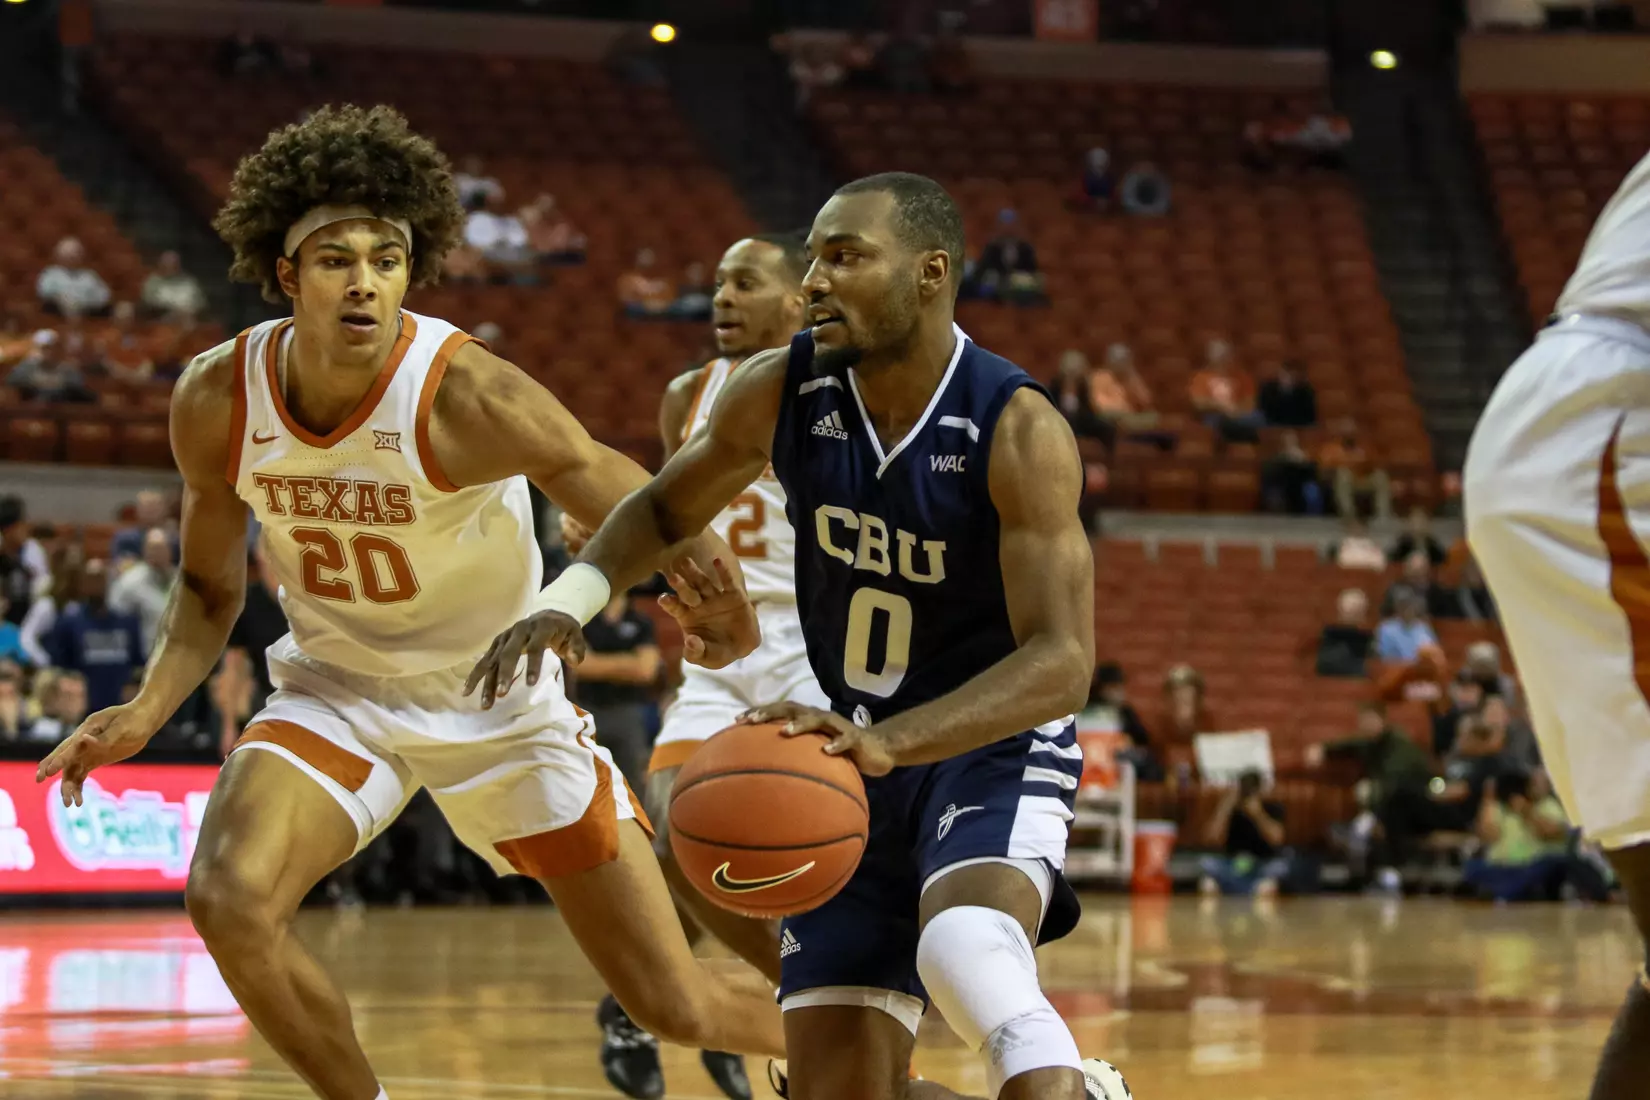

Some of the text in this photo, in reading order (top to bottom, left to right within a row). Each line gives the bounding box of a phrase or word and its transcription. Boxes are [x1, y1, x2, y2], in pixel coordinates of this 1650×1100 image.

[811, 425, 848, 440] adidas
[929, 455, 966, 472] WAC
[253, 472, 416, 526] TEXAS
[728, 491, 768, 558] 2
[288, 528, 421, 604] 20
[815, 504, 946, 583] CBU
[844, 586, 913, 698] 0
